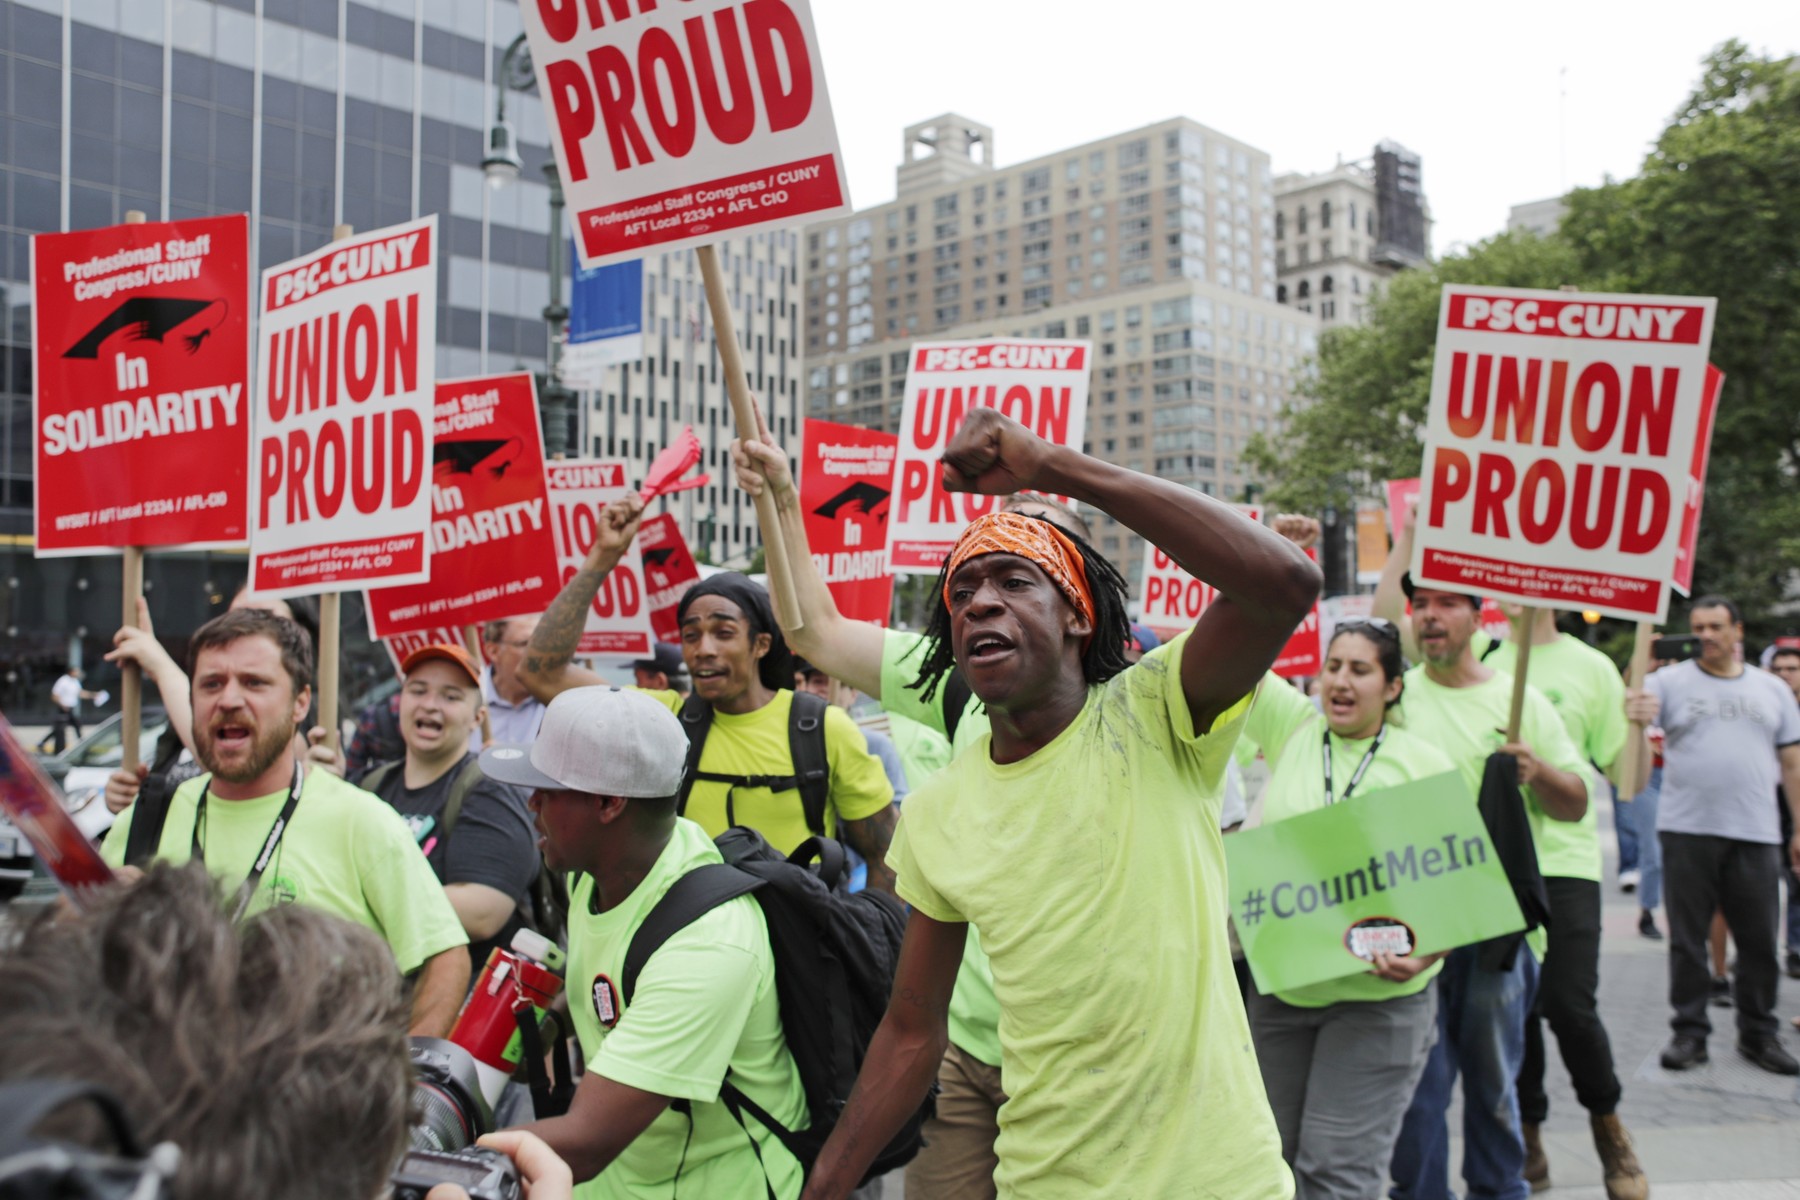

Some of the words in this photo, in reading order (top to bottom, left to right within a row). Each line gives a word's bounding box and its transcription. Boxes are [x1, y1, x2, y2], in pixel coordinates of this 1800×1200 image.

[545, 0, 813, 183] PROUD
[590, 203, 664, 229] Professional
[664, 193, 693, 211] Staff
[695, 178, 767, 203] Congress
[776, 164, 821, 186] CUNY
[624, 221, 649, 237] AFT
[650, 215, 681, 231] Local
[682, 208, 716, 224] 2334
[727, 198, 758, 215] AFL
[760, 190, 789, 207] CIO
[64, 243, 162, 282] Professional
[165, 234, 211, 261] Staff
[74, 257, 202, 301] Congress/CUNY
[275, 233, 420, 308] PSC-CUNY
[1463, 298, 1686, 341] PSC-CUNY
[115, 352, 149, 391] In
[268, 293, 419, 423] UNION
[924, 345, 1076, 371] PSC-CUNY
[43, 382, 242, 456] SOLIDARITY
[1447, 351, 1680, 457] UNION
[259, 408, 424, 531] PROUD
[548, 465, 616, 488] -CUNY
[99, 507, 116, 524] AFT
[117, 502, 142, 521] Local
[144, 499, 175, 516] 2334
[184, 491, 228, 511] AFL-CIO
[432, 483, 464, 514] In
[1429, 447, 1671, 555] PROUD
[262, 552, 308, 570] Professional
[309, 547, 330, 562] Staff
[331, 543, 380, 561] Congress
[387, 537, 416, 552] CUNY
[843, 518, 862, 546] In
[281, 566, 297, 579] AFT
[352, 557, 373, 571] AFL
[811, 549, 888, 584] OLIDARIT
[1432, 552, 1505, 574] Professional
[1506, 563, 1536, 579] Staff
[1537, 566, 1600, 587] Congress
[1608, 577, 1649, 593] CUNY
[1459, 568, 1484, 581] AFT
[1485, 571, 1519, 588] Local
[1560, 582, 1588, 596] AFL
[1145, 575, 1215, 618] PRO
[1241, 833, 1487, 926] #CountMeIn
